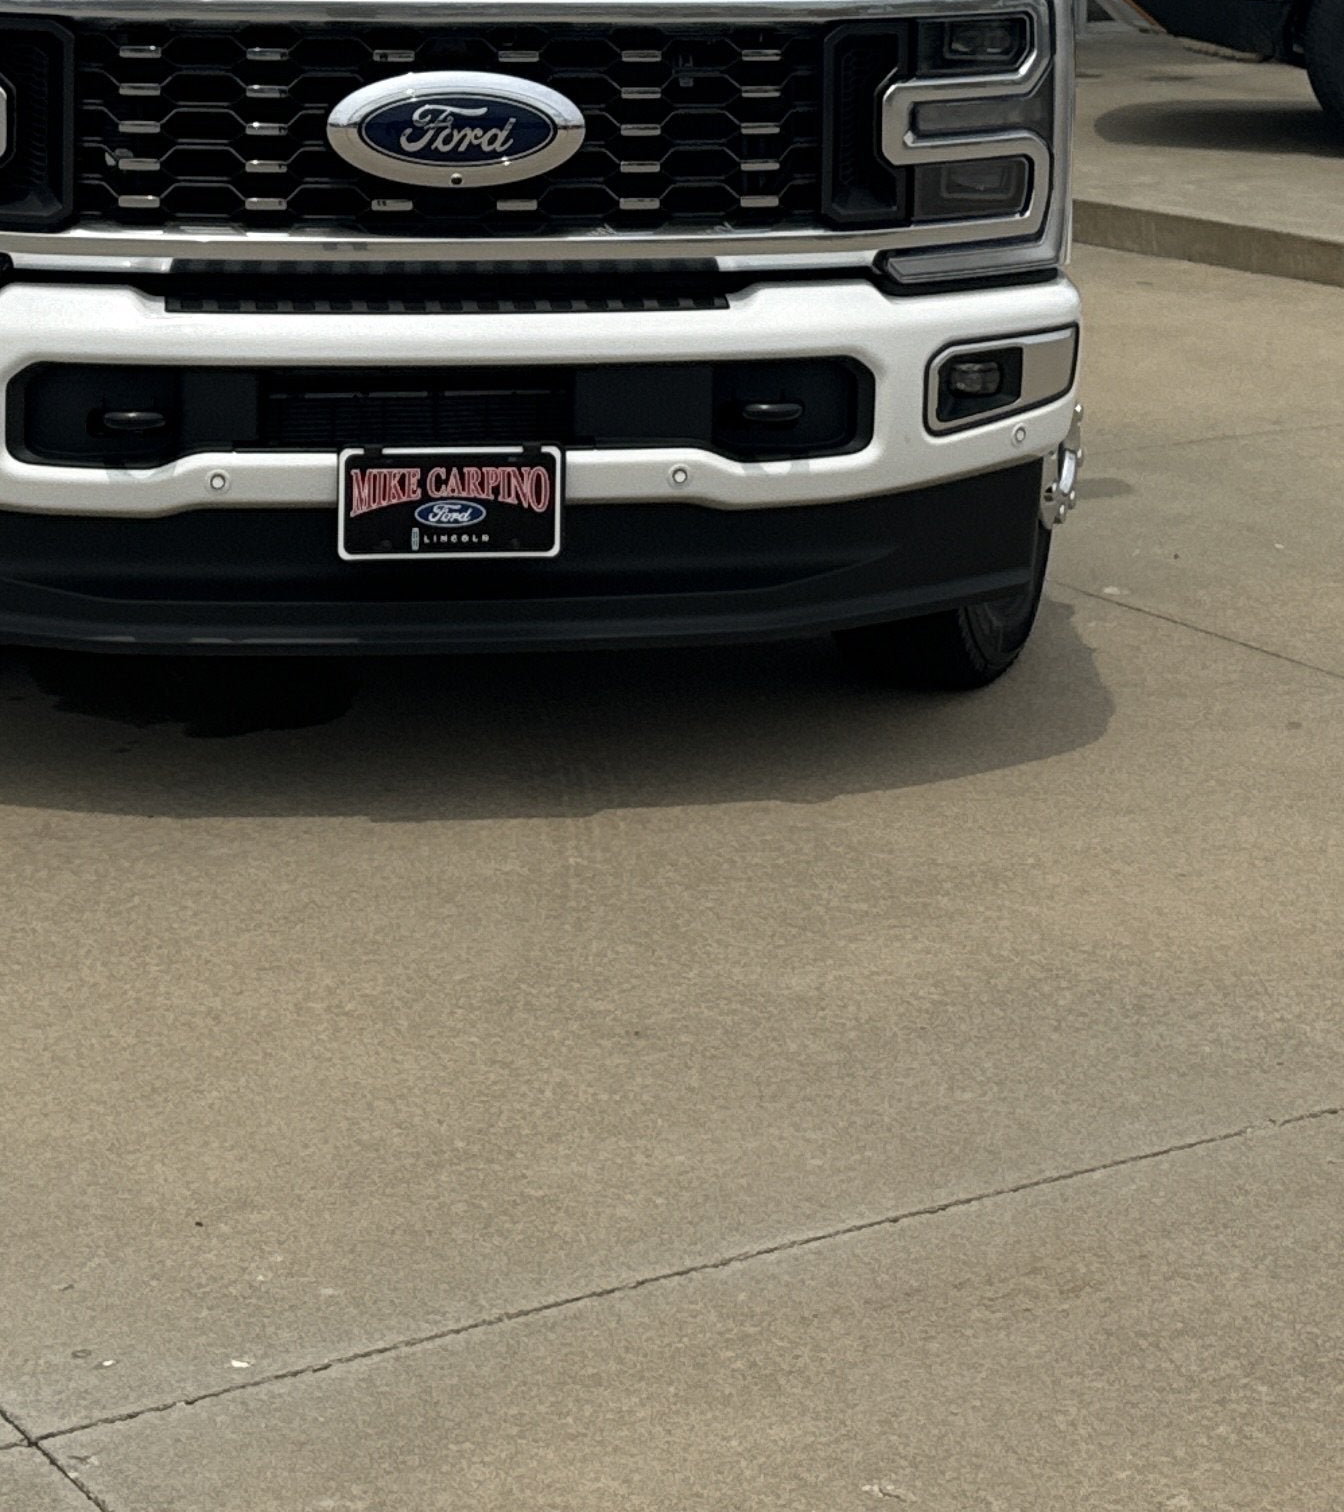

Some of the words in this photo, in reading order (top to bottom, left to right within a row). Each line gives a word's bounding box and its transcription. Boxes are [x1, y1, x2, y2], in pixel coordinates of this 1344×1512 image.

[399, 104, 517, 152] Ford
[350, 468, 422, 517] MIKE
[426, 466, 550, 512] CARPINO
[427, 503, 472, 523] Ford
